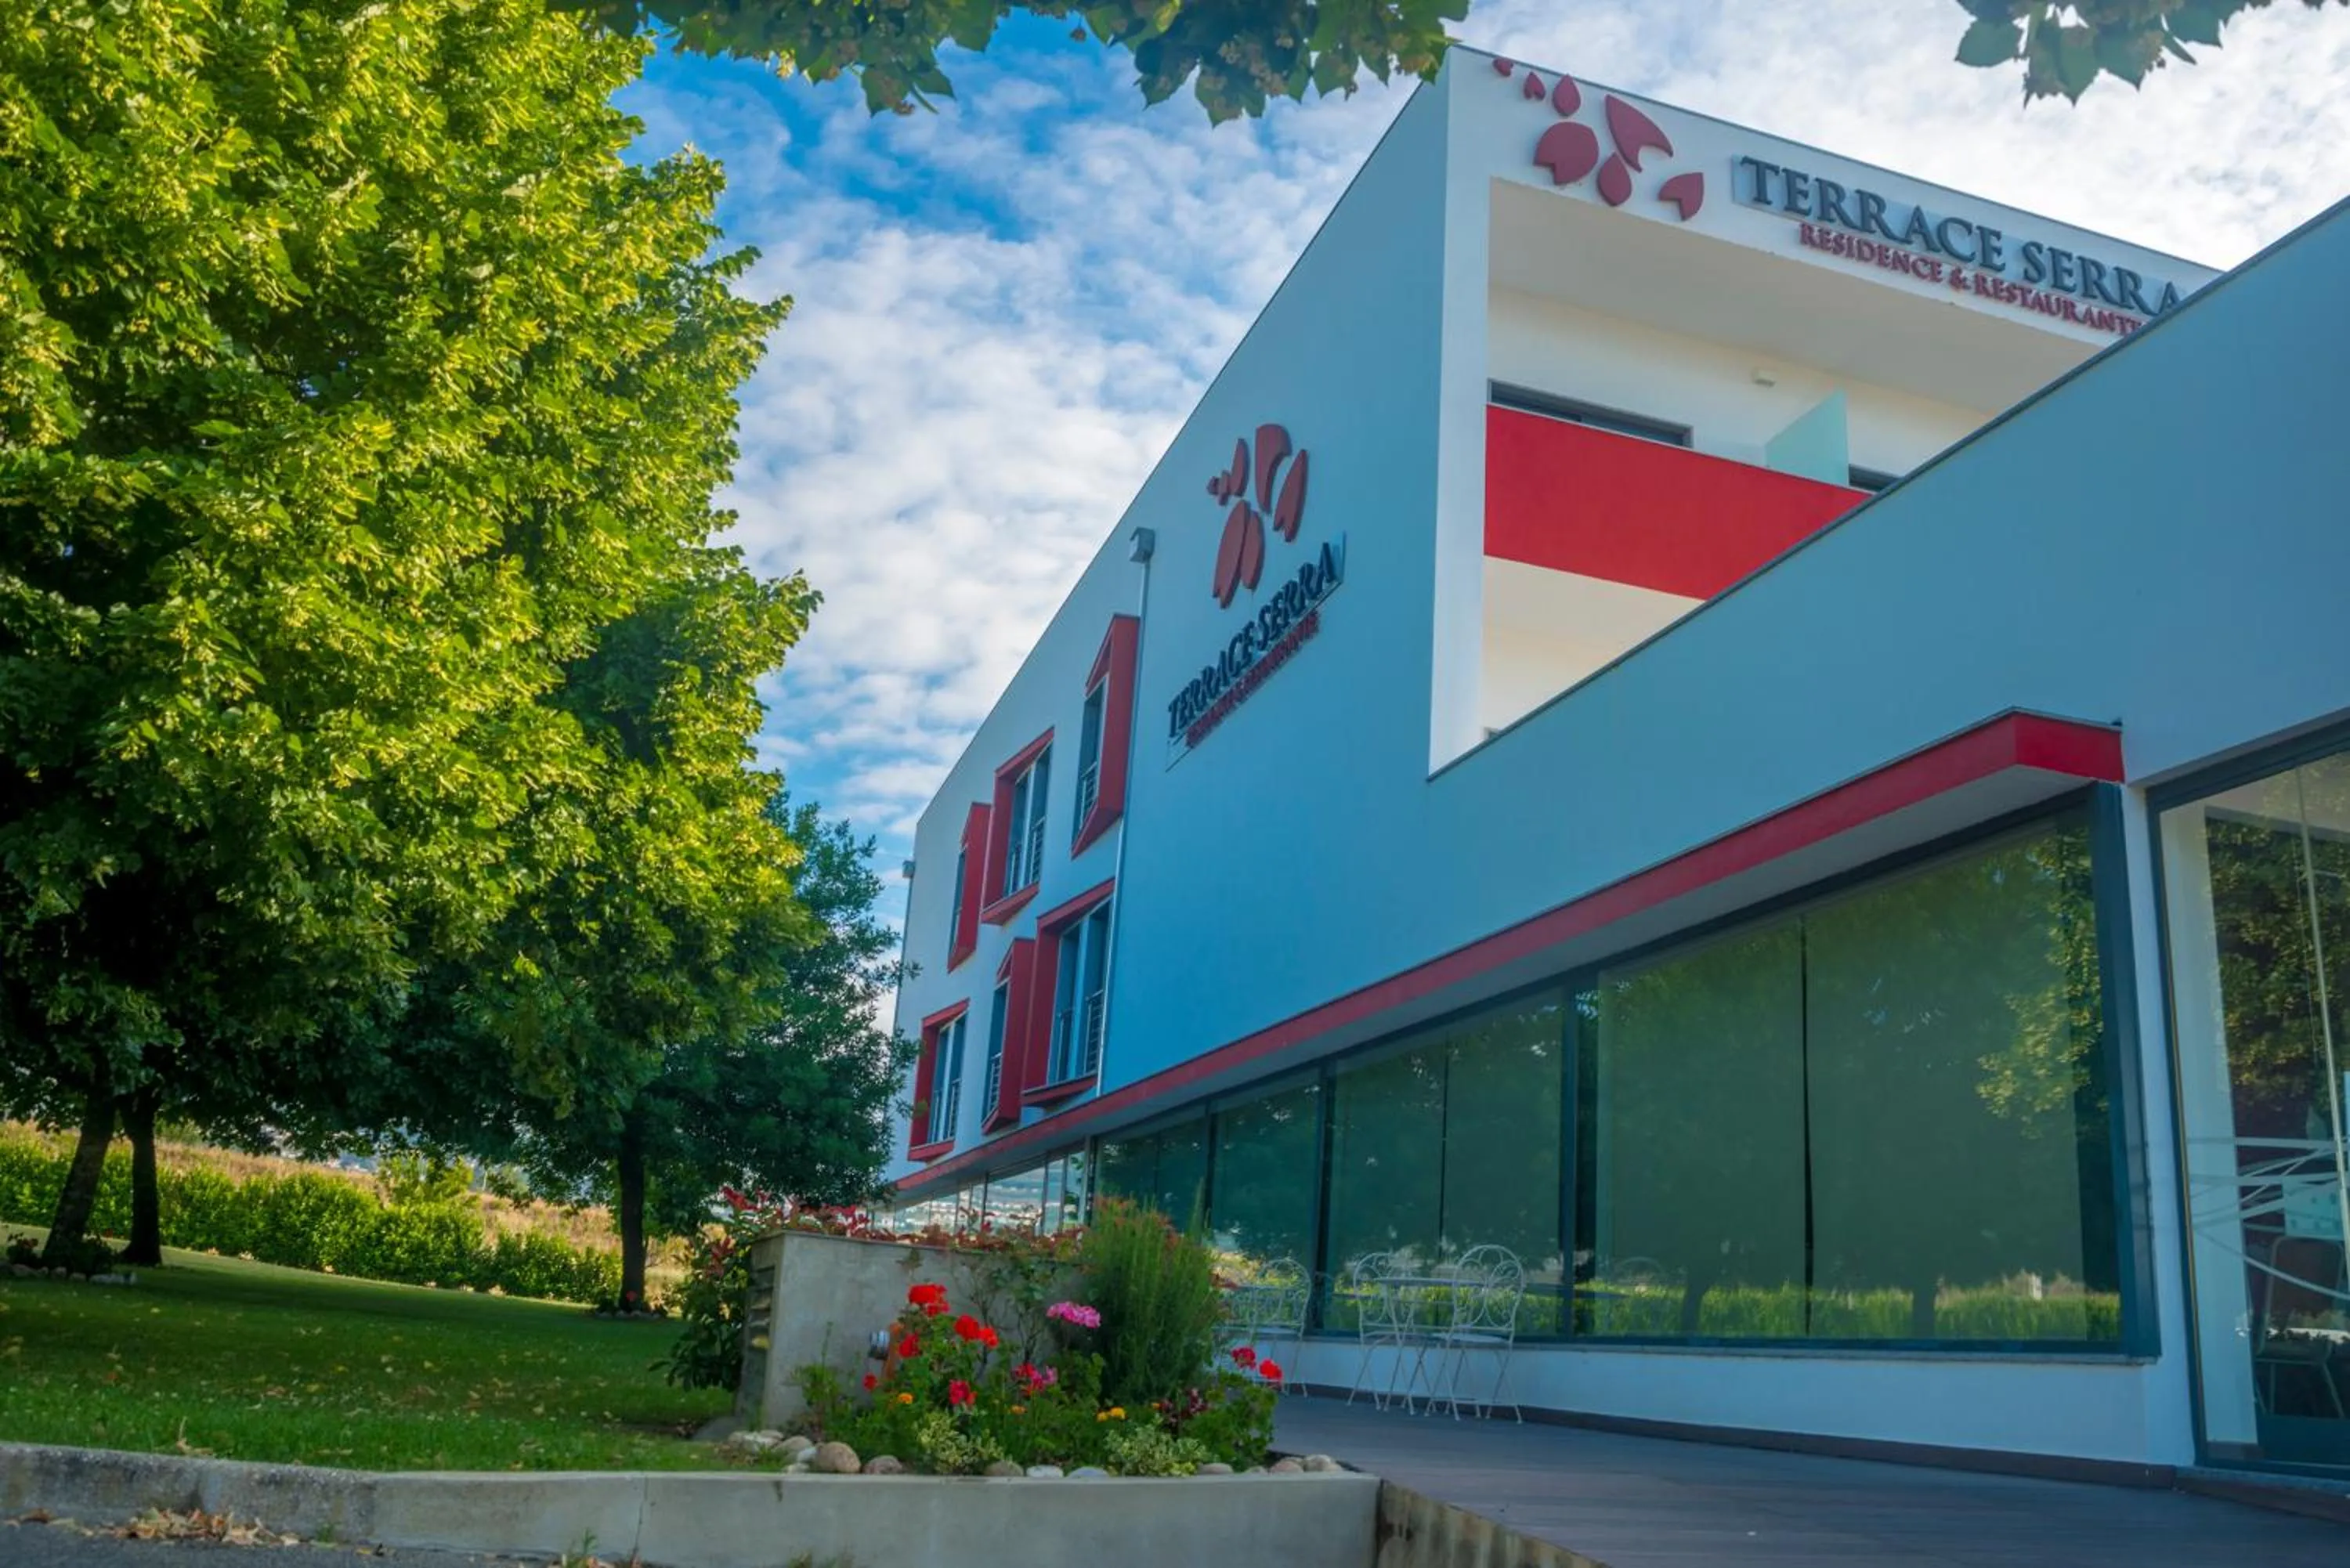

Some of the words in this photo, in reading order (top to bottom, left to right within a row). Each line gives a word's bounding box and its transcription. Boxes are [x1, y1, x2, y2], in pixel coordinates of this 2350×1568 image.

[1740, 156, 2006, 272] TERRACE
[2023, 240, 2182, 316] SERRA
[1799, 222, 1943, 283] RESIDENCE
[1949, 266, 1971, 292] &
[1168, 621, 1255, 738] TERRACE
[1256, 542, 1338, 652] SERRA
